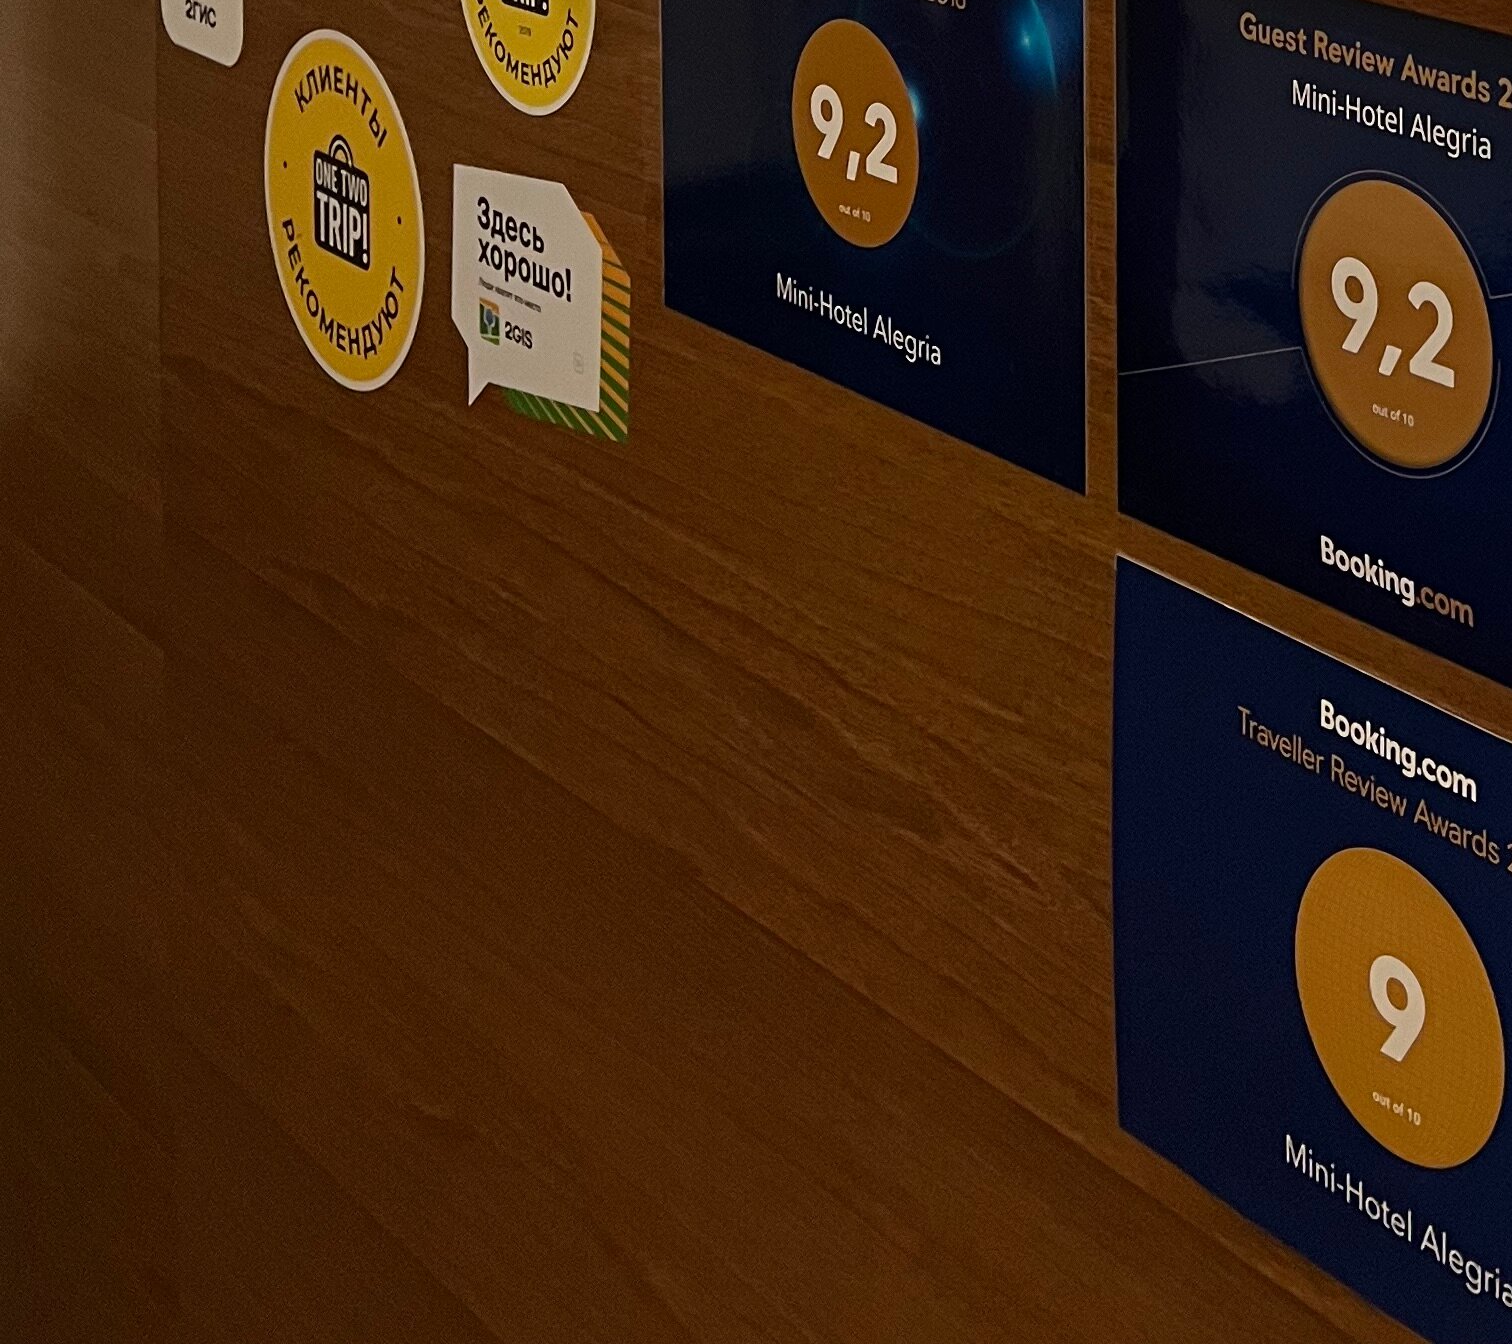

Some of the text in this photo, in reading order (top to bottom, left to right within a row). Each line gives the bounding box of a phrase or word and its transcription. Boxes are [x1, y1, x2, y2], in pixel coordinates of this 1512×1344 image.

[1239, 11, 1307, 56] Guest
[1313, 29, 1395, 76] Review
[1401, 54, 1491, 105] Awards
[294, 64, 388, 149] КЛИЕНТЫ
[809, 83, 898, 185] 9,2
[1291, 79, 1492, 162] Mini-Hotel Alegria
[315, 157, 368, 207] ONE TWO
[316, 190, 369, 264] TRIP!
[477, 196, 545, 254] Здесь
[282, 218, 405, 360] РЕКОМЕНДУЮТ
[478, 237, 572, 303] хорошо!
[504, 321, 533, 350] 2GIS
[776, 271, 942, 367] Mini-Hotel Alegria
[1330, 255, 1455, 388] 9,2
[1402, 413, 1414, 427] 10
[1319, 534, 1475, 628] Booking.com
[1237, 706, 1324, 775] Traveller
[1330, 755, 1407, 818] Review
[1413, 798, 1500, 866] Awards
[1319, 698, 1478, 803] Booking.com
[1367, 953, 1427, 1063] 9
[1407, 1107, 1421, 1126] 10
[1285, 1134, 1413, 1244] Mini-Hotel
